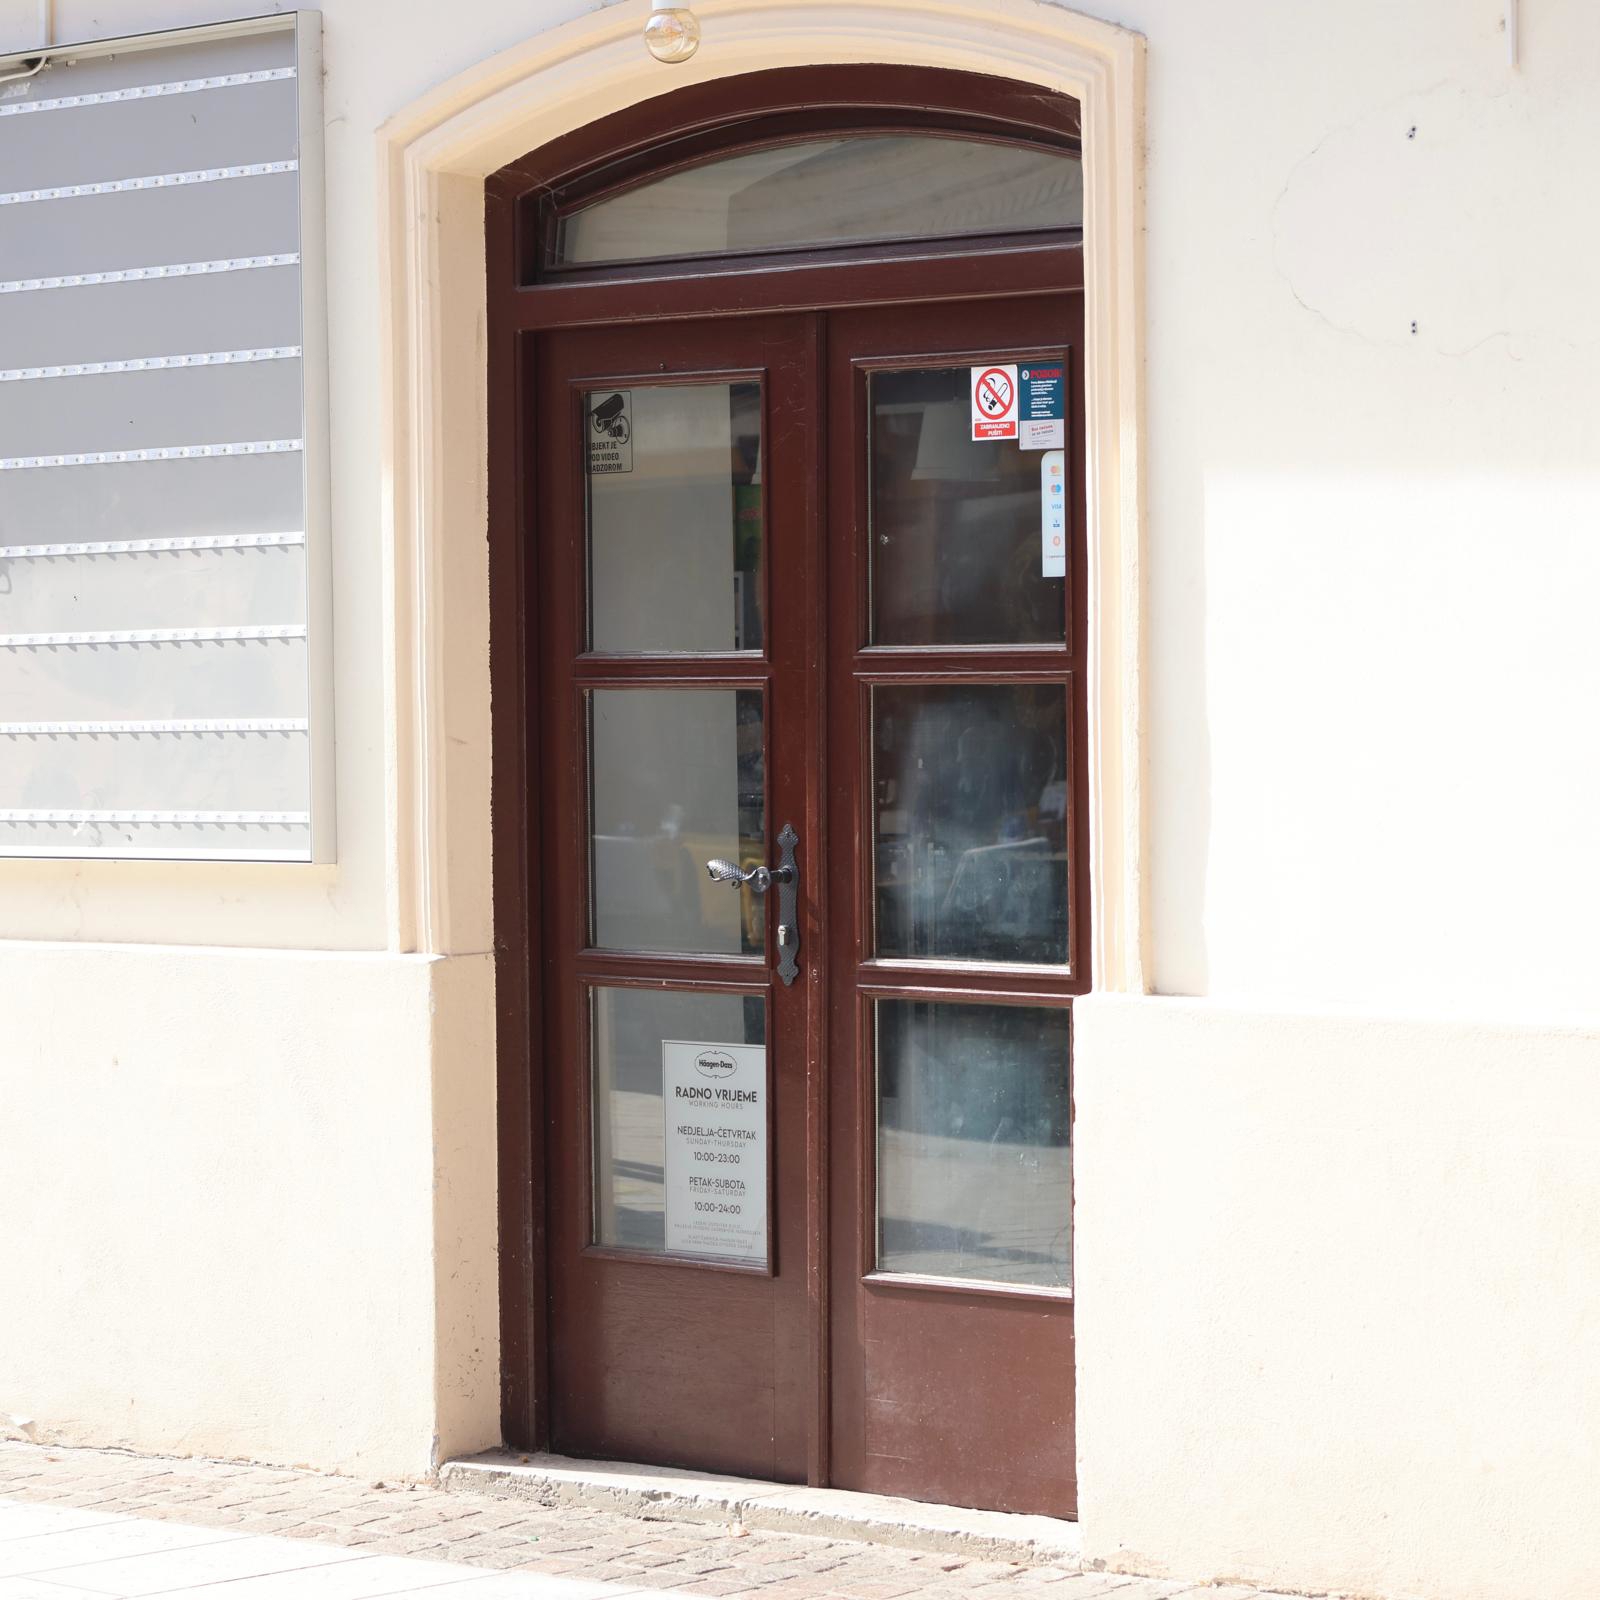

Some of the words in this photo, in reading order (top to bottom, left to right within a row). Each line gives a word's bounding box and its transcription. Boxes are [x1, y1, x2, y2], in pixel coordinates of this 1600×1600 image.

[591, 442, 609, 450] BJEKT
[602, 452, 619, 461] VIDEO
[592, 463, 622, 472] ADZOROM
[699, 1059, 733, 1070] Häagen-Dazs
[675, 1086, 712, 1099] RADNO
[715, 1088, 758, 1102] VRIJEME
[689, 1100, 718, 1108] WORKING
[721, 1102, 744, 1110] HOURS
[677, 1125, 757, 1140] NEDJELJA-ČETVRTAK
[686, 1137, 747, 1148] SUNDAY-THURSDAY
[693, 1151, 741, 1164] 10:00-23:00
[689, 1176, 746, 1190] PETAK-SUBOTA
[689, 1186, 746, 1197] FRIDAY-SATURDAY
[694, 1201, 741, 1215] 10:00-24:00
